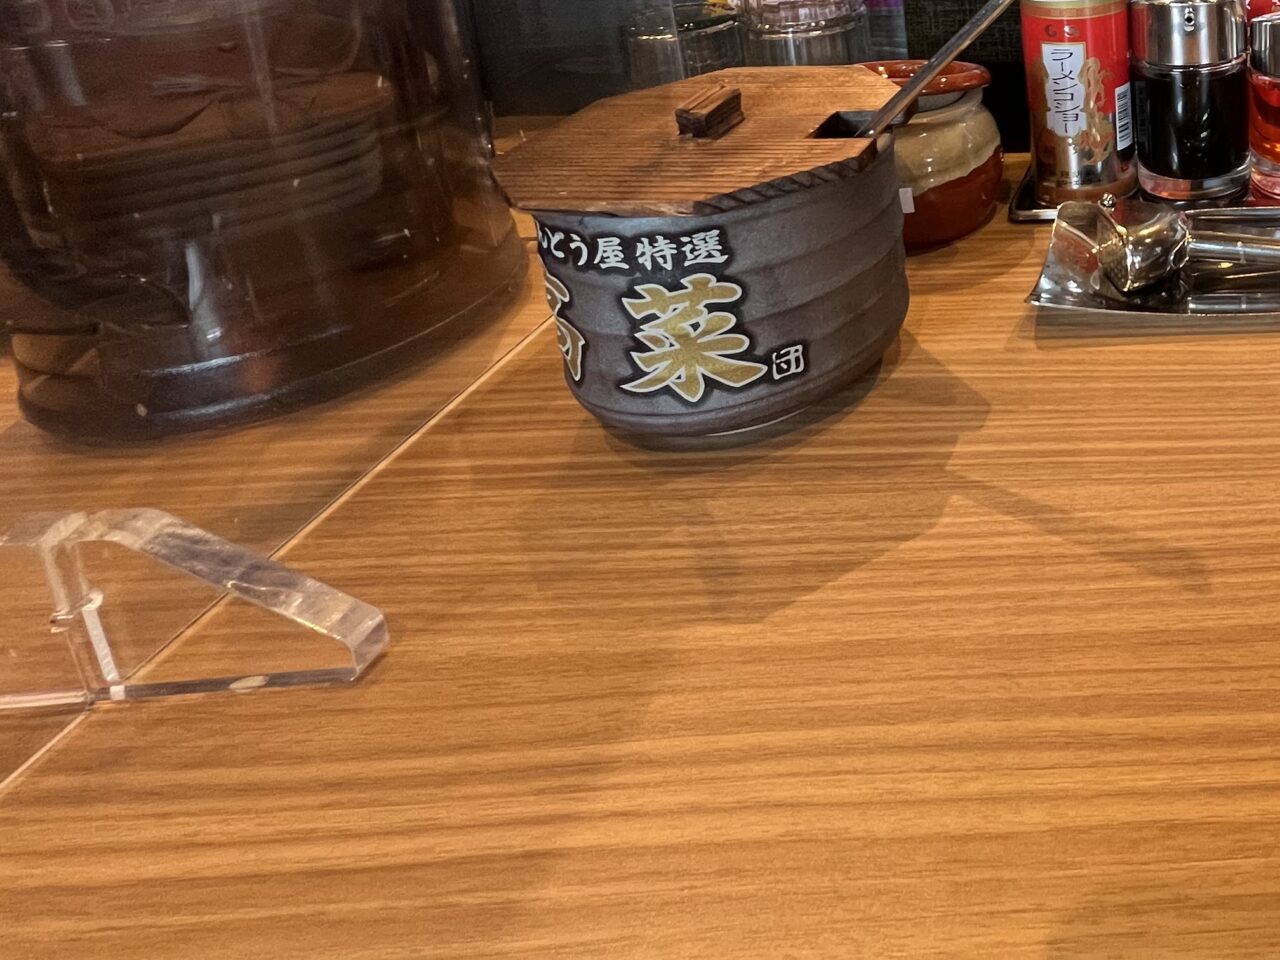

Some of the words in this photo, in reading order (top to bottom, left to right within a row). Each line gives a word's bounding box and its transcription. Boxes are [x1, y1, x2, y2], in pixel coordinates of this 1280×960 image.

[1049, 48, 1079, 134] ラーメンコショー
